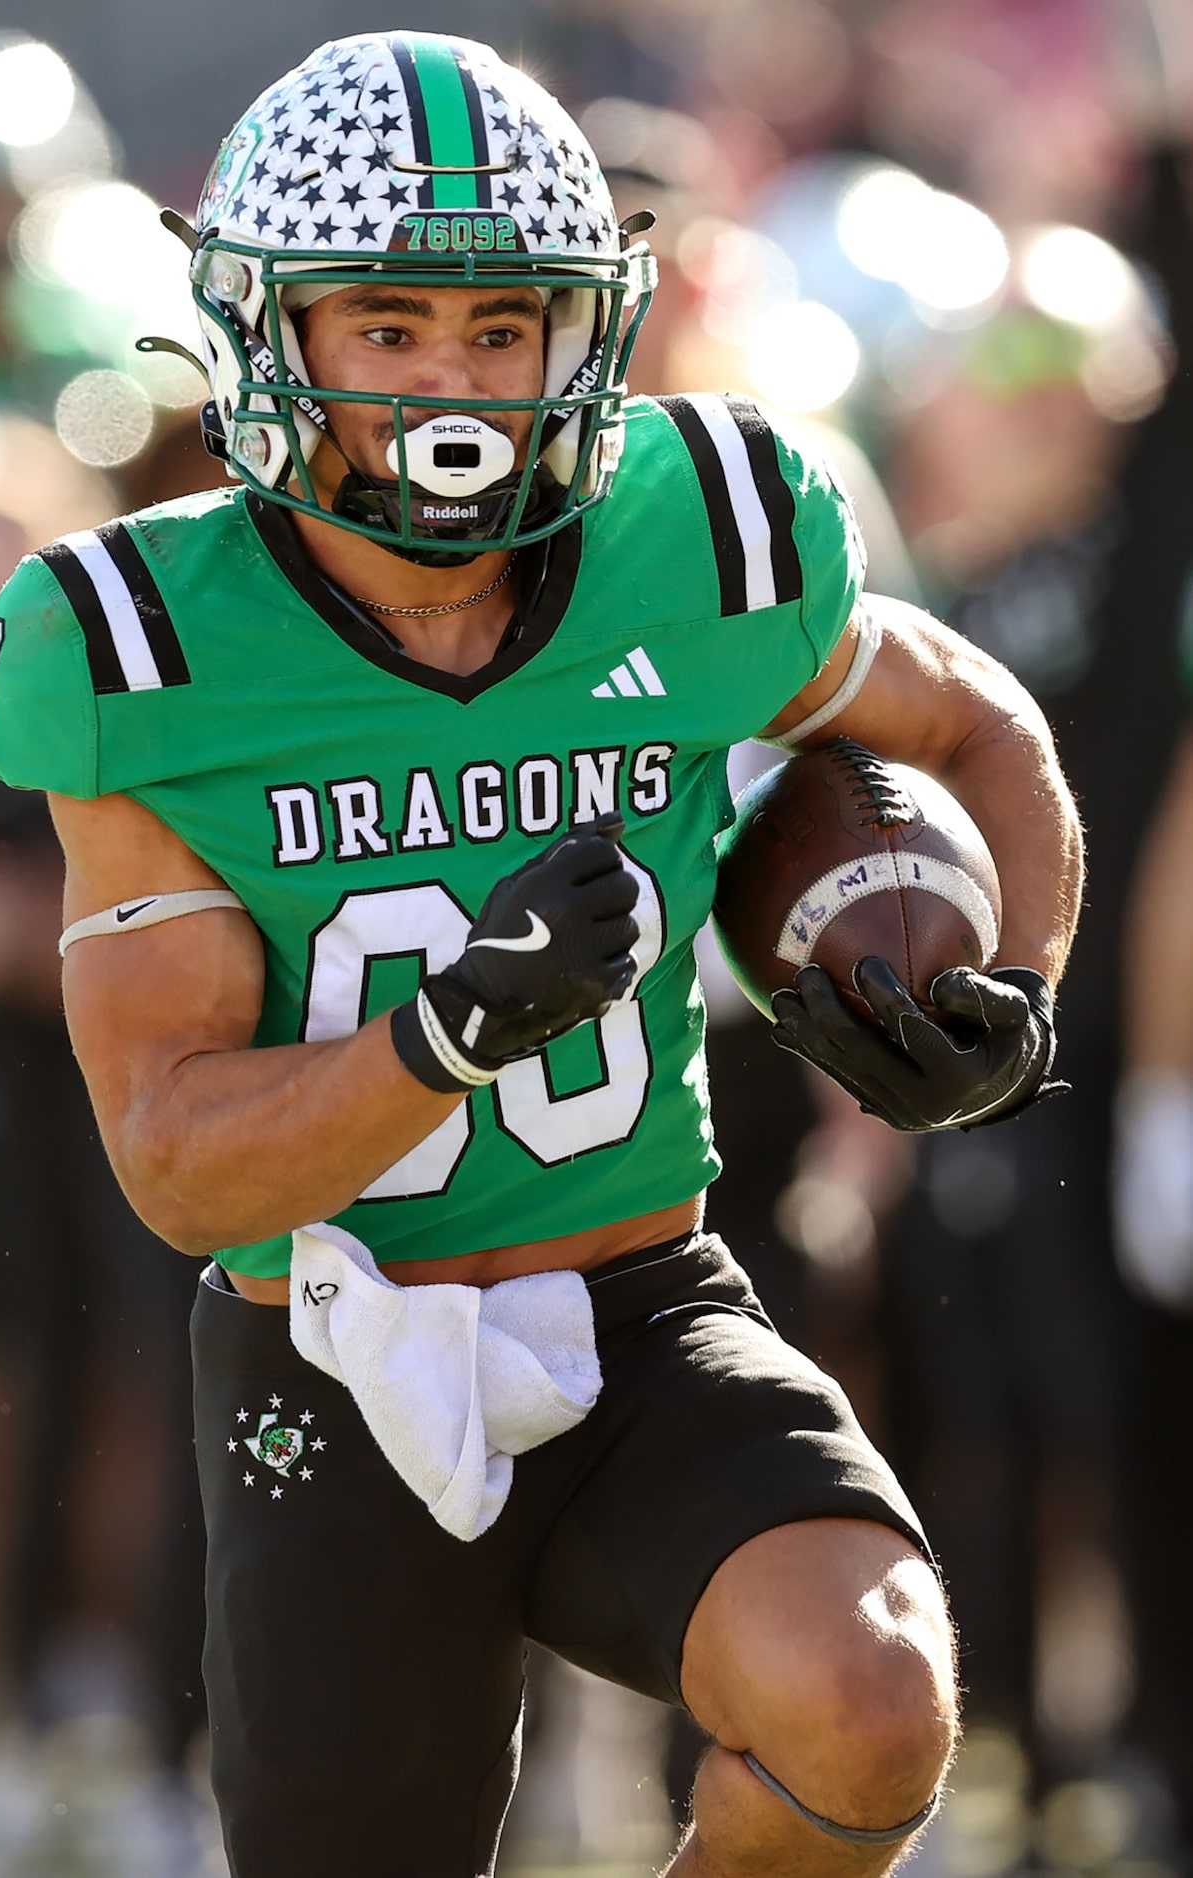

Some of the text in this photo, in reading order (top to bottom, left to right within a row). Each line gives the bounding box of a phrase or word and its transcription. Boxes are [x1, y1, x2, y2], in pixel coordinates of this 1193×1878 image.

[404, 217, 516, 250] 76092
[432, 425, 482, 435] SHOCK
[423, 505, 479, 519] Riddell
[264, 741, 677, 868] DRAGONS
